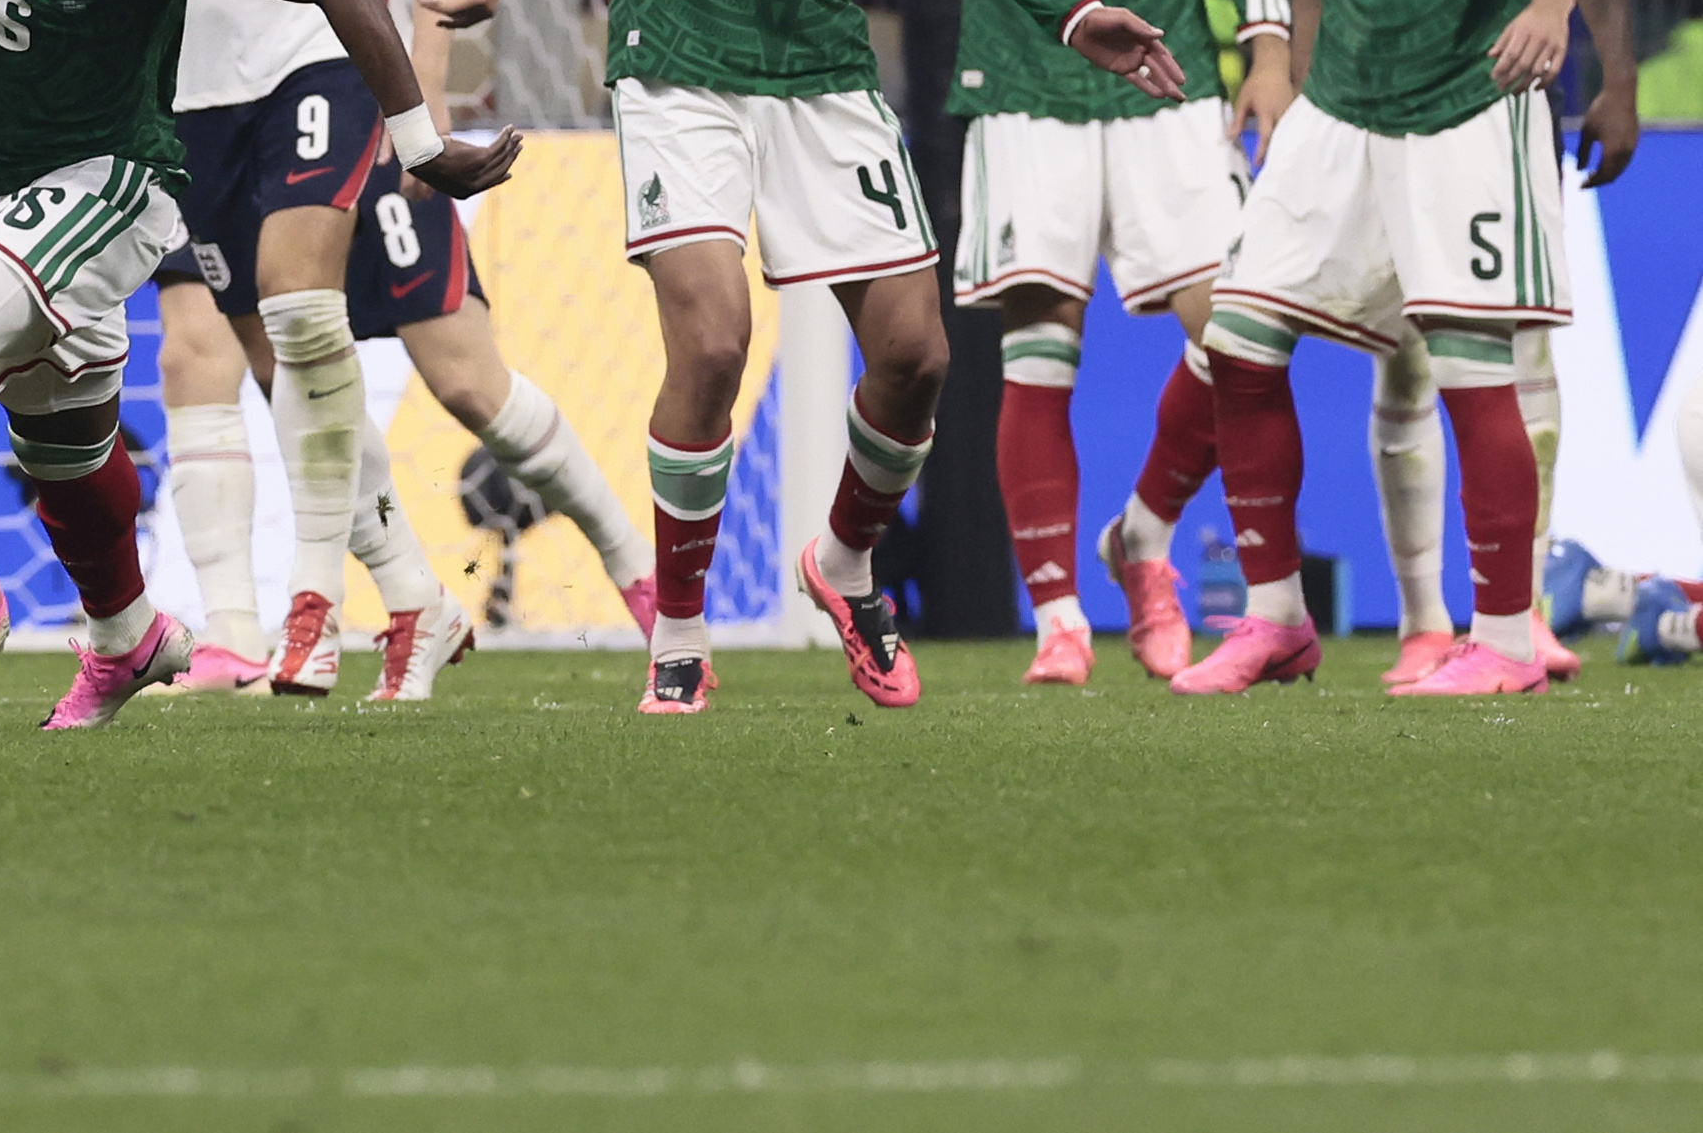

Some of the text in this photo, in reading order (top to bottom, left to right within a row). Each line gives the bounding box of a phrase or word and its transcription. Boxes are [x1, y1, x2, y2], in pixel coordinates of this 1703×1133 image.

[296, 94, 331, 160] 9
[857, 159, 907, 230] 4
[375, 193, 422, 268] 8
[1470, 213, 1502, 280] 5
